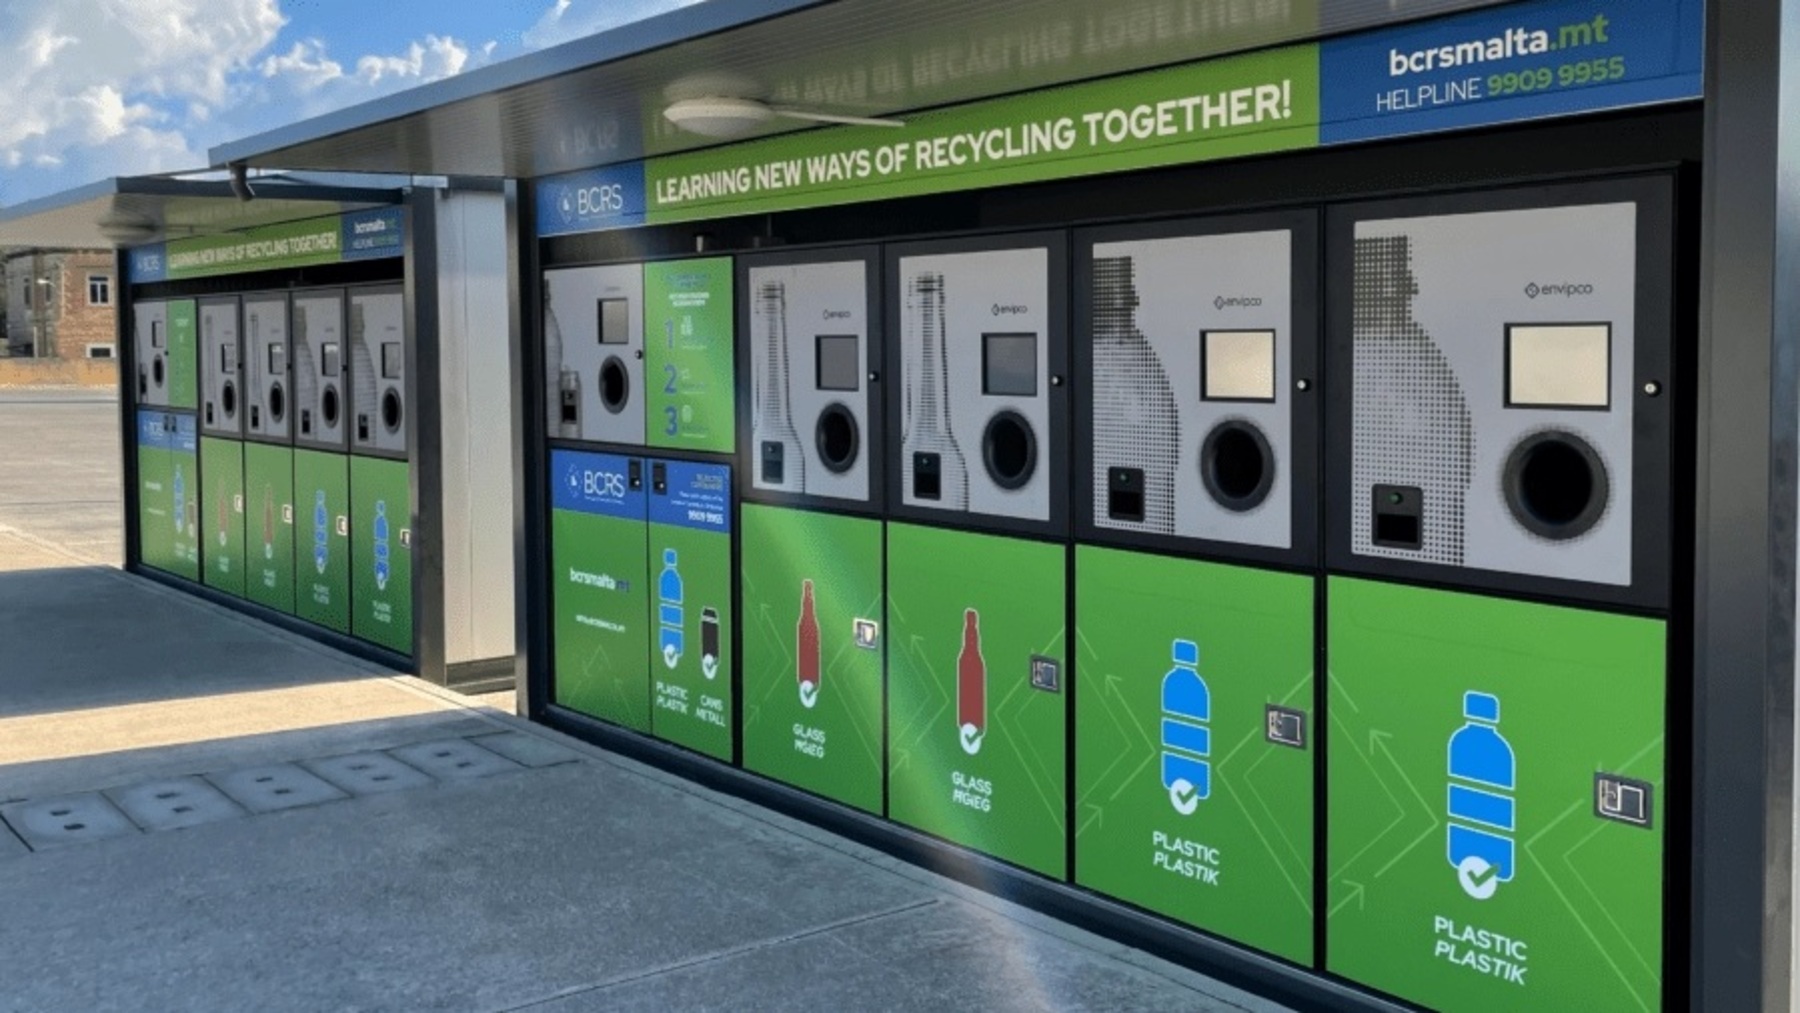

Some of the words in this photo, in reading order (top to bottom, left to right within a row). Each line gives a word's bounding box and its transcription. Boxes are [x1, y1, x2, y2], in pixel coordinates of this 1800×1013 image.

[1389, 14, 1609, 76] bcrsmalta.mt
[1377, 77, 1482, 112] HELPLINE
[1487, 67, 1553, 97] 9909
[1557, 56, 1625, 87] 9955
[656, 167, 751, 204] LEARNING
[755, 159, 803, 190] NEW
[806, 150, 871, 184] WAYS
[875, 144, 909, 174] OF
[915, 117, 1076, 170] RECYCLING
[1083, 79, 1292, 146] TOGETHER!
[578, 183, 624, 215] BCRS
[1541, 283, 1594, 299] envipco
[663, 363, 678, 394] 2
[664, 405, 679, 437] 3
[584, 470, 626, 498] BCRS
[656, 681, 689, 700] PLASTIC
[700, 694, 724, 712] CANS
[792, 723, 826, 745] GLASS
[952, 771, 993, 796] GLASS
[1152, 830, 1221, 866] PLASTIC
[1152, 850, 1221, 887] PLASTIK
[1434, 914, 1529, 961] PLASTIC
[1434, 939, 1529, 986] PLASTIK
